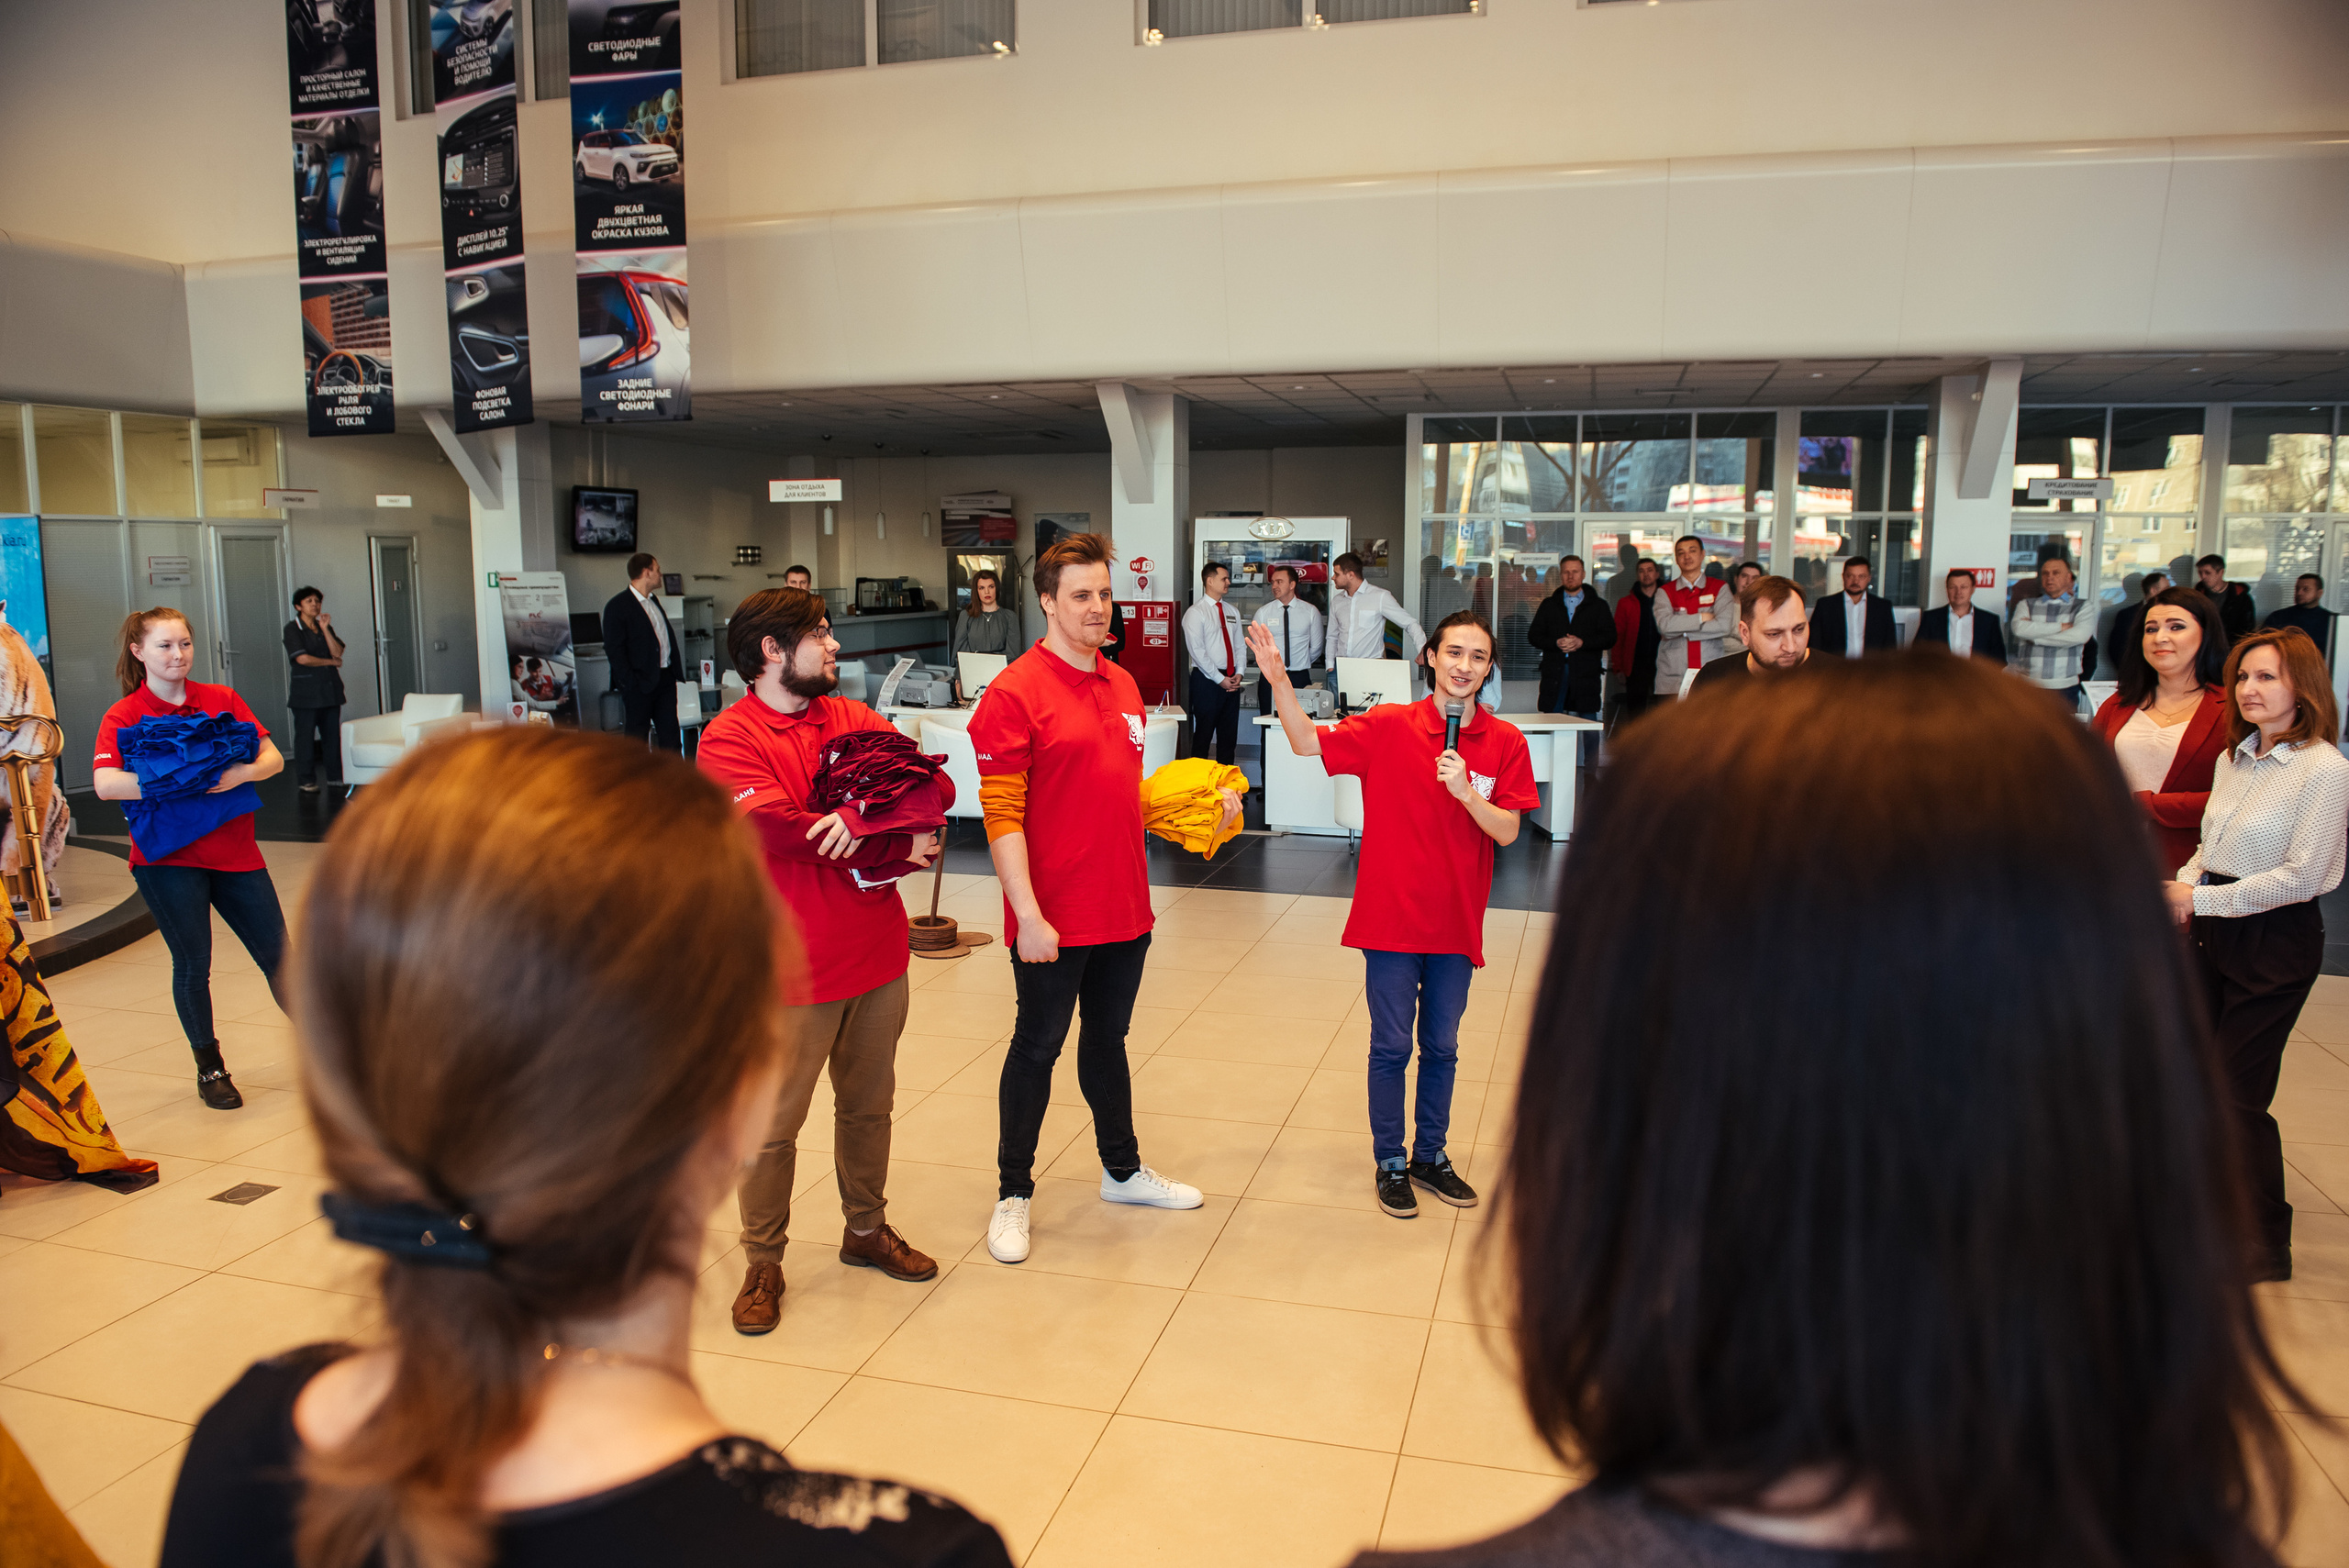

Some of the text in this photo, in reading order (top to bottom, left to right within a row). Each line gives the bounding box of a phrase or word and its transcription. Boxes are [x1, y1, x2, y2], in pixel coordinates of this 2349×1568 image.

[455, 38, 487, 55] СИСТЕМЫ
[588, 36, 662, 52] СВЕТОДИОДНЫЕ
[447, 44, 498, 68] БЕЗОПАСНОСТИ
[611, 50, 638, 62] ФАРЫ
[454, 56, 491, 75] И ПОМОЩИ
[300, 68, 366, 83] ПРОСТОРНЫЙ САЛОН
[454, 66, 492, 85] ВОДИТЕЛЮ
[306, 79, 362, 93] И КАЧЕСТВЕННЫЕ
[298, 87, 370, 103] МАТЕРИАЛЫ ОТДЕЛКИ
[614, 204, 644, 216] ЯРКАЯ
[597, 214, 662, 228] ДВУХЦВЕТНАЯ
[457, 229, 488, 248] ДИСПЛЕЙ
[591, 226, 670, 239] ОКРАСКА КУЗОВА
[304, 234, 377, 248] ЭЛЕКТРОРЕГУЛИРОВКА
[458, 237, 507, 257] С НАВИГАЦИЕЙ
[322, 244, 365, 256] ВЕНТИЛЯЦИЯ
[316, 384, 381, 395] ЭЛЕКТРООБОГРЕВ
[618, 377, 653, 389] ЗАДНИЕ
[475, 385, 507, 399] ФОНОВАЯ
[599, 388, 672, 401] СВЕТОДИОДНЫЕ
[338, 395, 359, 405] РУЛЯ
[472, 396, 512, 411] ПОДСВЕТКА
[617, 400, 655, 411] ФОНАРИ
[326, 406, 373, 417] И ЛОБОВОГО
[479, 408, 506, 421] САЛОНА
[336, 417, 366, 427] СТЕКЛА
[1257, 522, 1287, 536] KIA
